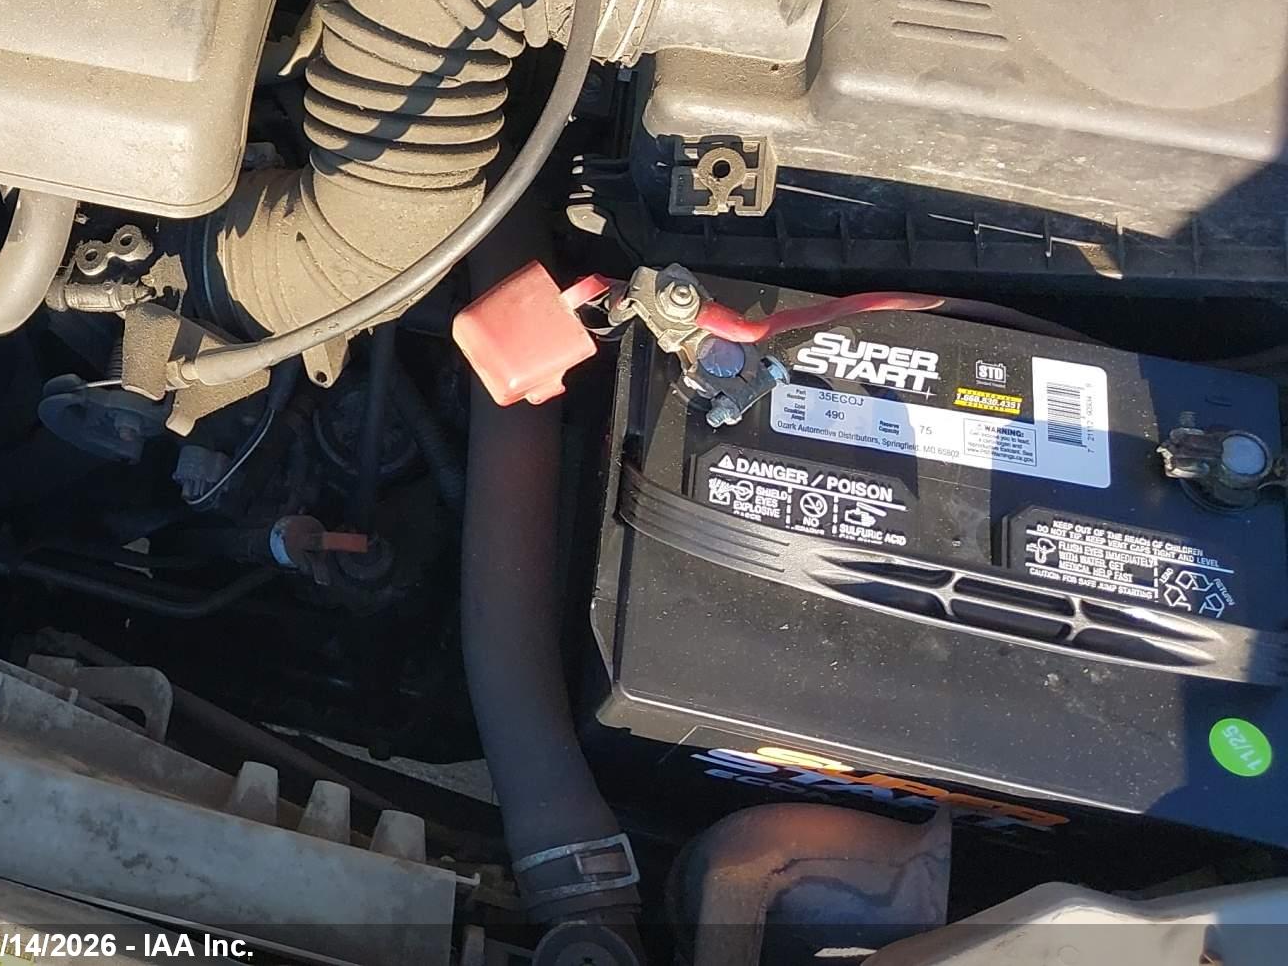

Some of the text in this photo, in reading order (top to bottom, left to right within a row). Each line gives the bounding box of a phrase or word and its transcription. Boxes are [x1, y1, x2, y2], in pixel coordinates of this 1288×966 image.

[813, 331, 939, 372] SUPER
[792, 347, 941, 392] START
[978, 365, 1003, 381] STD
[824, 409, 845, 421] 490
[777, 420, 797, 432] Ozark
[798, 423, 837, 438] Automotive
[838, 430, 881, 446] Distributors,
[878, 426, 900, 436] Capacity
[919, 425, 933, 435] 75
[984, 424, 1025, 439] WARNING:
[735, 457, 893, 503] DANGER / POISON
[755, 485, 788, 501] SHIELD
[755, 496, 779, 509] EYES
[732, 501, 781, 519] EXPLOSIVE
[802, 516, 820, 528] NO
[839, 523, 884, 542] SULFURIC
[884, 532, 907, 546] ACID
[1052, 519, 1204, 557] KEEP OUT OF THE REACH OF CHILDREN
[1036, 524, 1049, 534] DO
[1050, 526, 1068, 538] NOT
[1085, 533, 1107, 546] KEEP
[1107, 538, 1129, 551] VENT
[1129, 542, 1151, 555] CAPS
[1151, 546, 1178, 560] TIGHT
[1178, 552, 1195, 563] AND
[1196, 555, 1220, 568] LEVEL
[1058, 540, 1154, 568] FLUSH EYES IMMEDIATELY
[1058, 550, 1080, 564] WITH
[1108, 560, 1126, 572] GET
[1058, 560, 1134, 583] MEDICAL HELP FAST
[1062, 573, 1078, 584] FOR
[1078, 576, 1098, 588] SAFE
[1098, 579, 1118, 592] JUMP
[1117, 584, 1154, 599] STARTING
[1159, 567, 1175, 584] LEAD
[1213, 577, 1236, 607] RETURN
